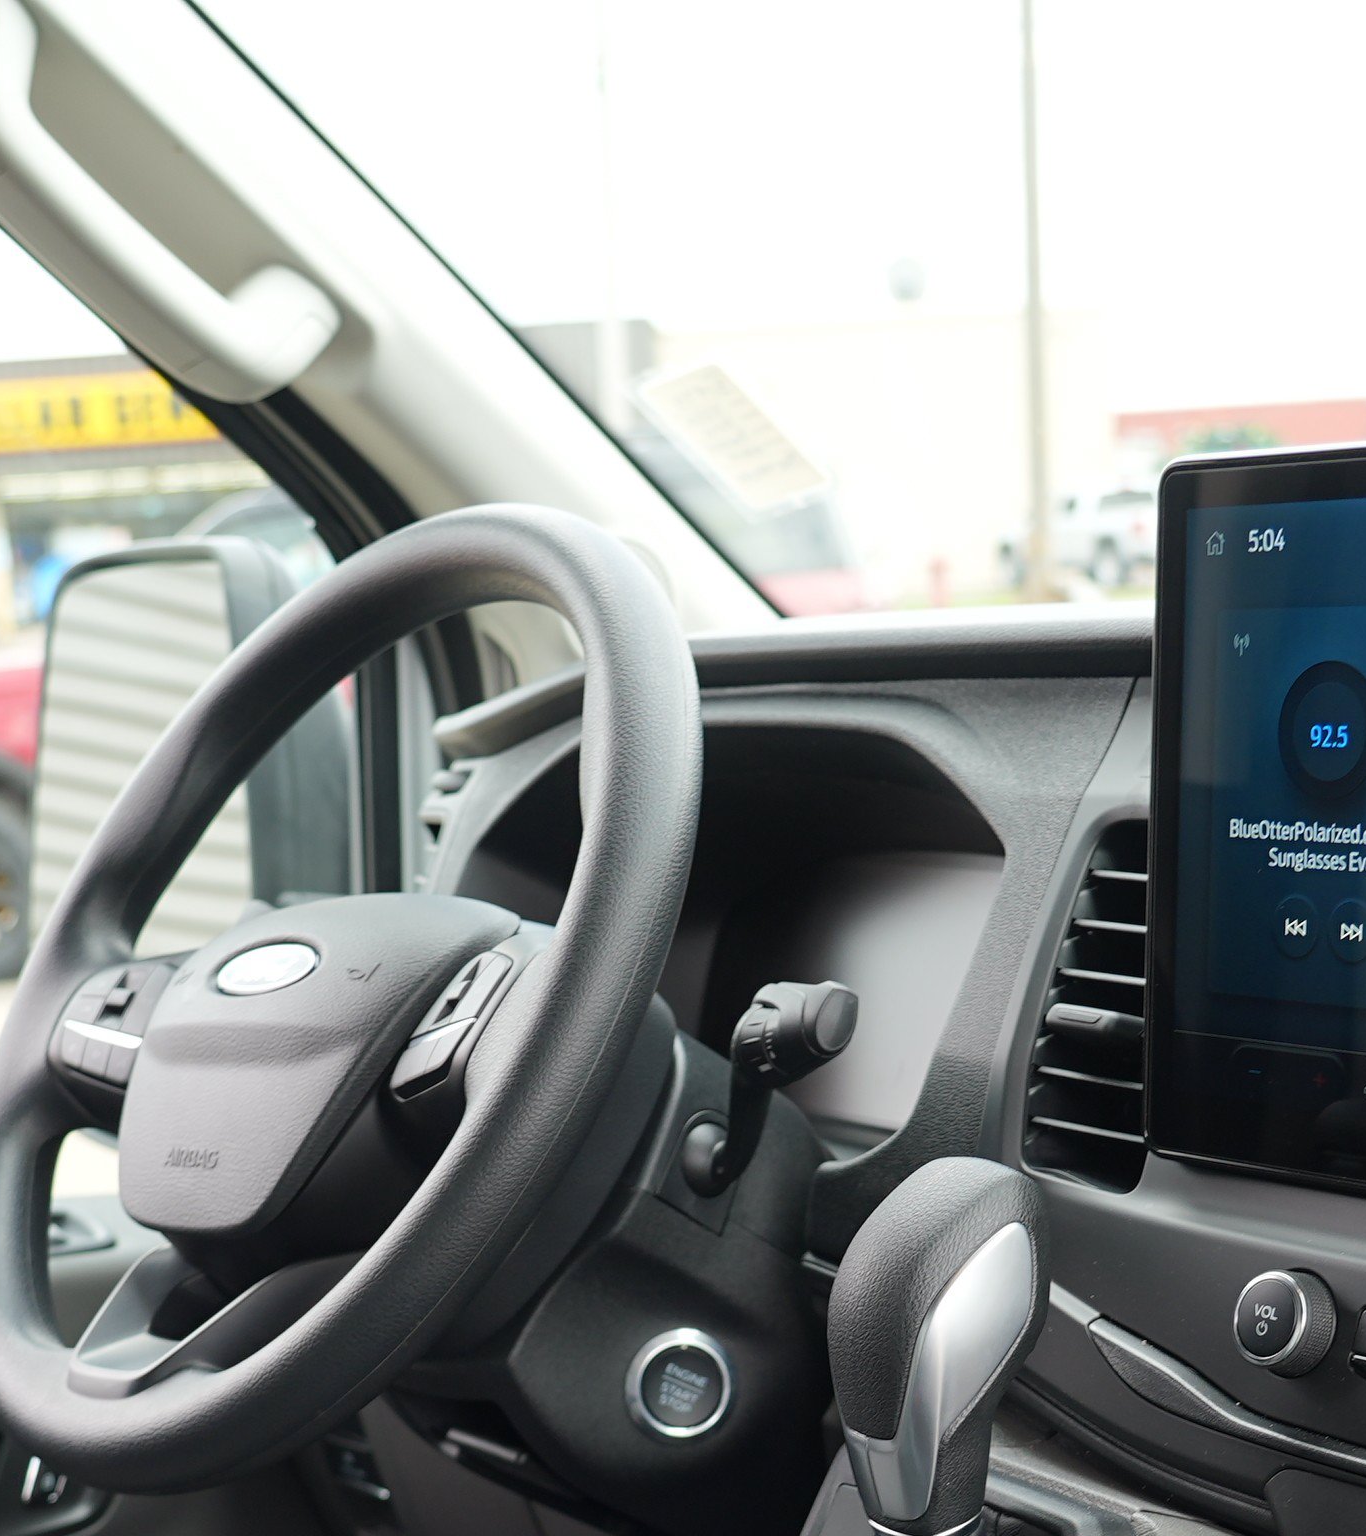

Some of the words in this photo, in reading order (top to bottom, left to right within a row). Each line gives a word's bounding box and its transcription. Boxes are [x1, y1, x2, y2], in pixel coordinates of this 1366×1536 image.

[1247, 527, 1286, 553] 5:04
[1309, 724, 1349, 749] 92.5
[1267, 847, 1347, 873] Sunglasses
[163, 1147, 220, 1170] AIRBAG
[1253, 1302, 1279, 1322] VOL
